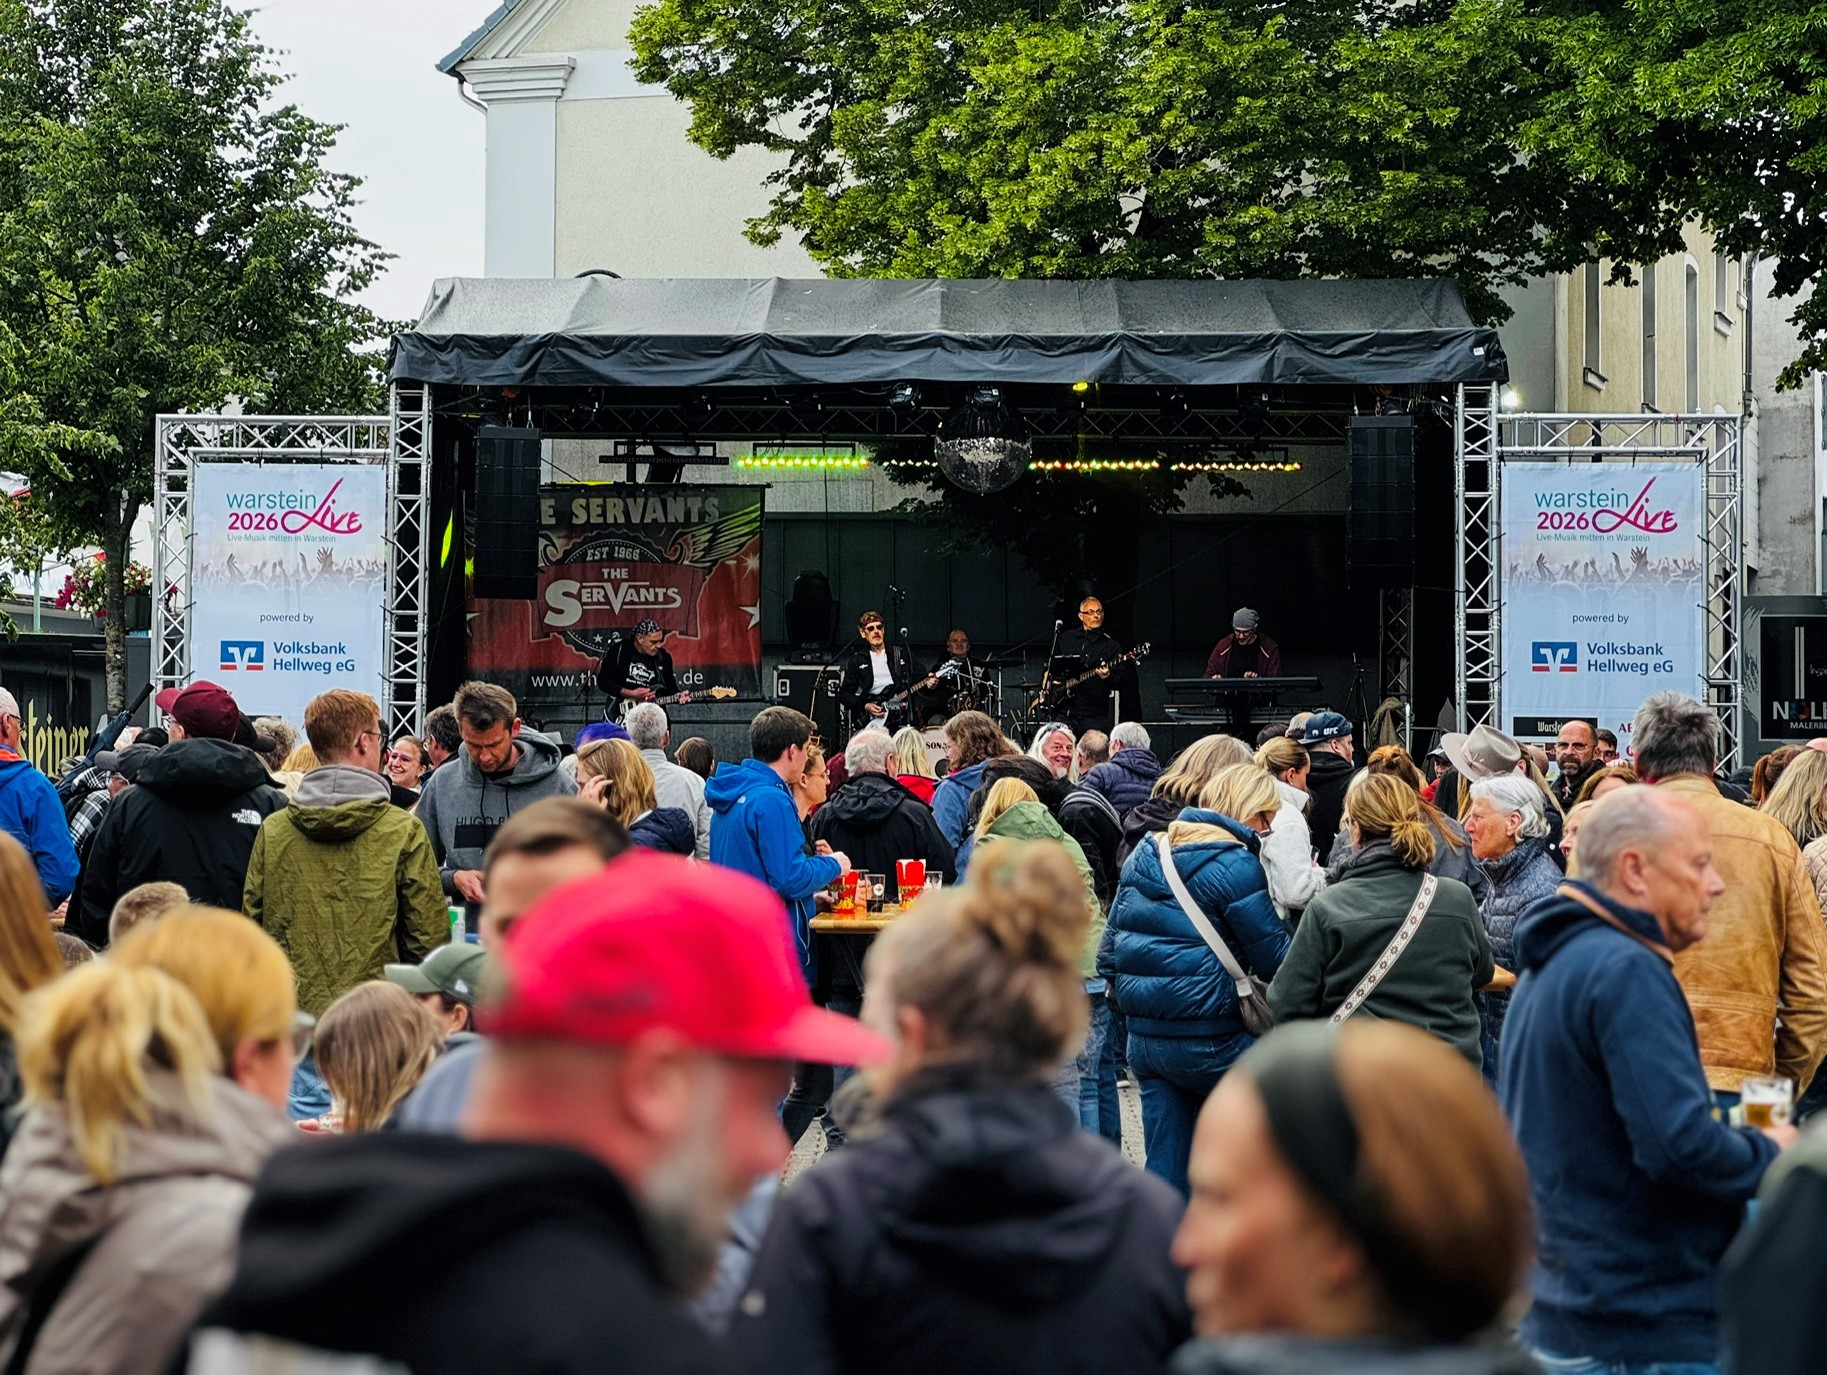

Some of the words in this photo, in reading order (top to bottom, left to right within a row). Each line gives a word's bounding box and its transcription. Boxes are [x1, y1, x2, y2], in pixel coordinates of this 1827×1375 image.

[227, 490, 317, 509] warstein
[1535, 488, 1629, 508] warstein
[571, 496, 719, 525] SERVANTS
[228, 512, 278, 531] 2026
[1537, 511, 1589, 530] 2026
[227, 534, 267, 542] Live-Musik
[268, 534, 293, 542] mitten
[294, 534, 302, 542] in
[303, 535, 336, 543] Warstein
[1536, 533, 1578, 542] Live-Musik
[1579, 533, 1605, 542] mitten
[1607, 534, 1614, 542] in
[1616, 534, 1650, 542] Warstein
[586, 547, 607, 561] EST
[613, 546, 641, 561] 1966
[602, 568, 628, 579] THE
[259, 613, 300, 624] powered
[302, 613, 314, 624] by
[1572, 613, 1614, 624] powered
[1617, 613, 1629, 625] by
[273, 641, 346, 655] Volksbank
[1587, 642, 1664, 656] Volksbank
[273, 658, 332, 674] Hellweg
[335, 659, 355, 672] eG
[1587, 659, 1649, 676] Hellweg
[1653, 660, 1673, 673] eG
[1323, 727, 1339, 735] UFC
